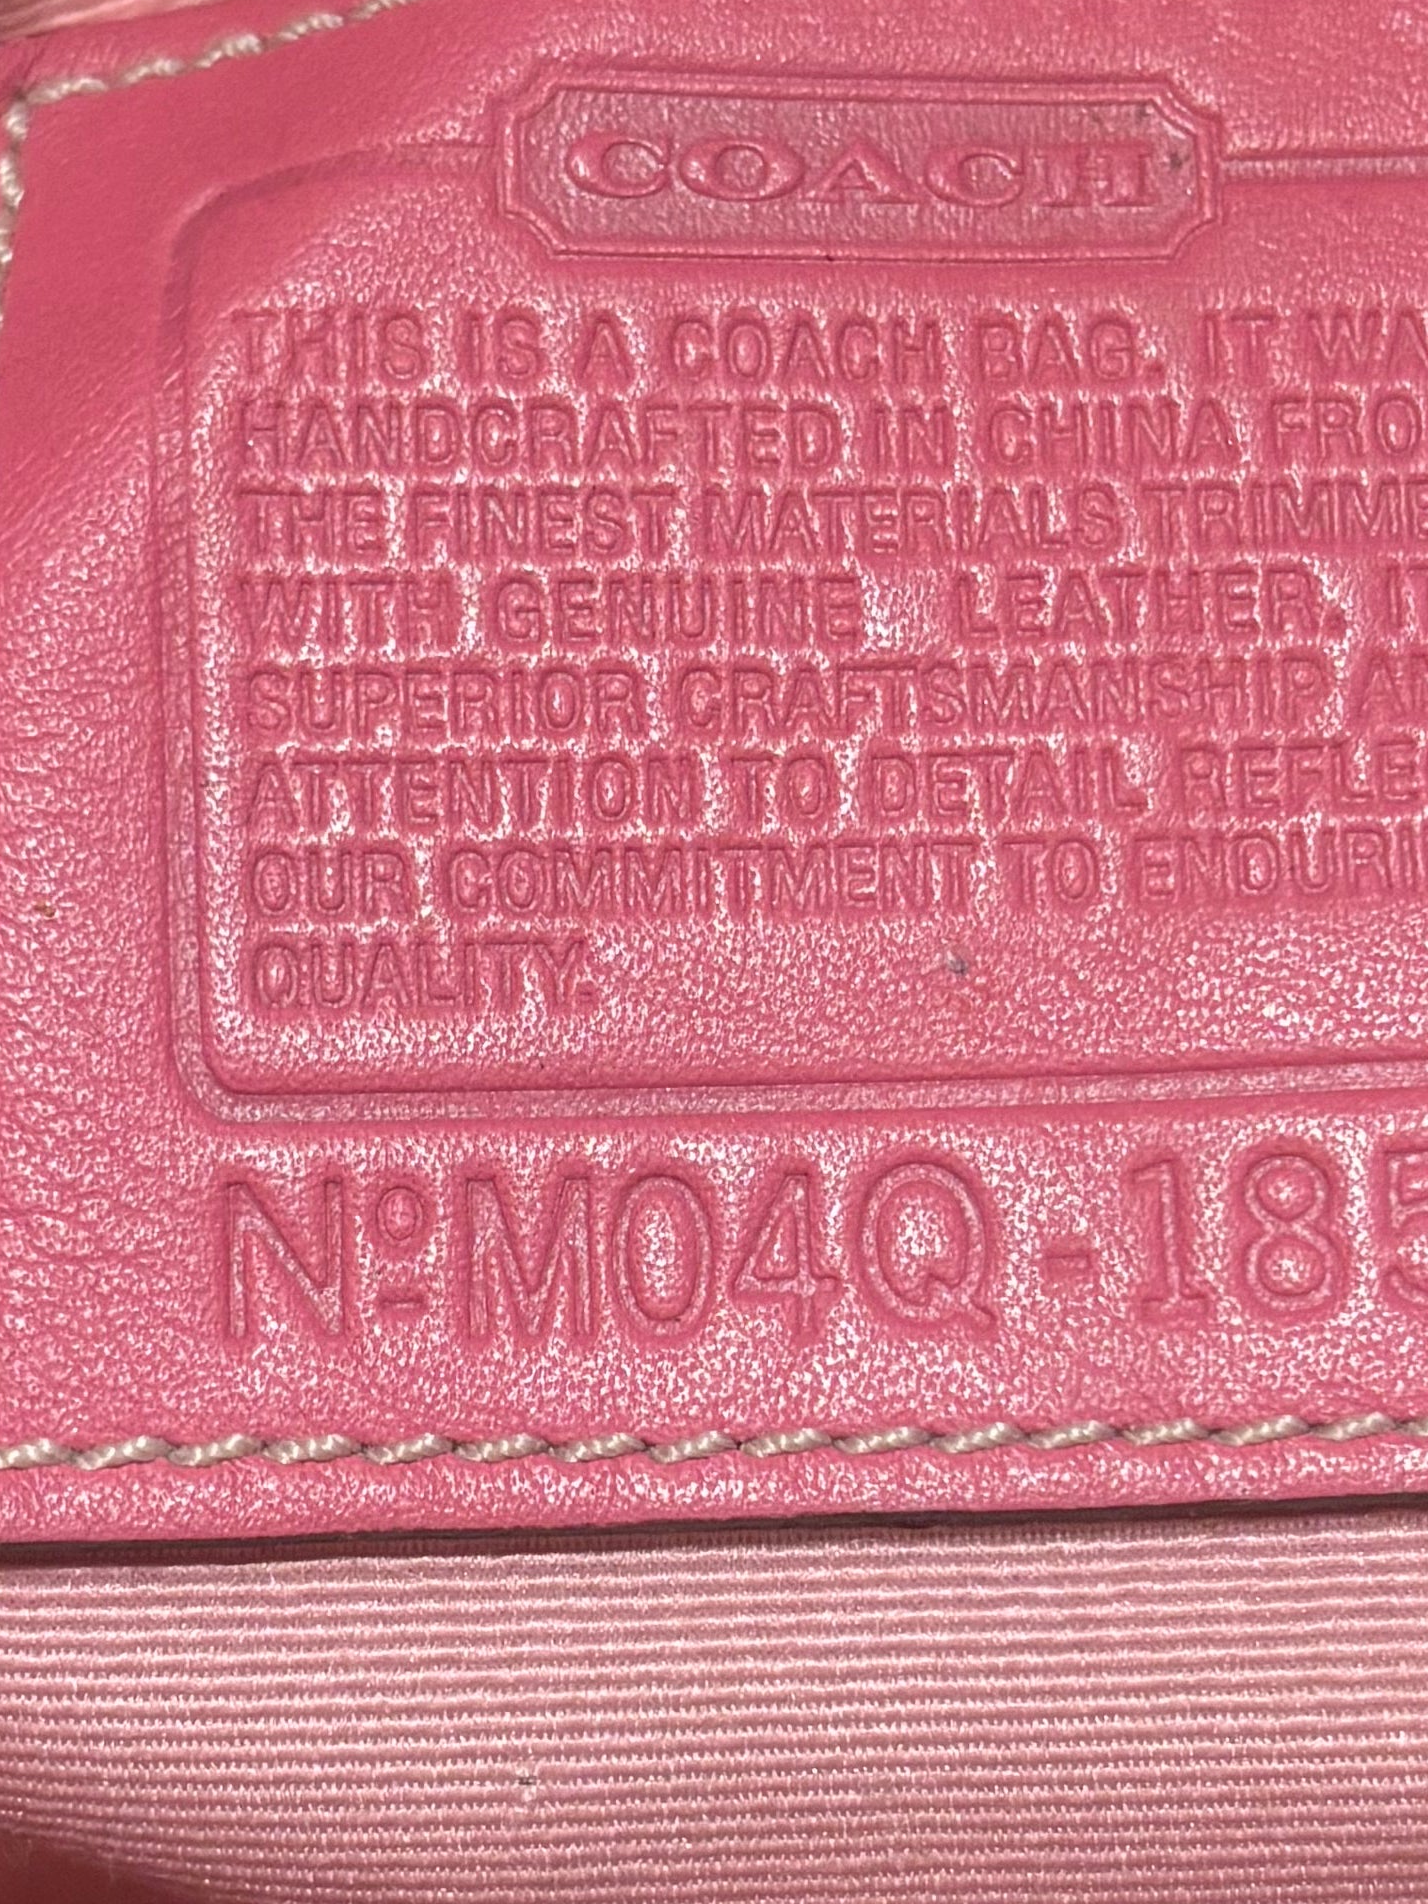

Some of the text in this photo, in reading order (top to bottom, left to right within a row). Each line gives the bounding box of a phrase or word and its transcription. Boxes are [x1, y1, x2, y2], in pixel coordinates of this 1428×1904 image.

[574, 136, 1156, 208] COACH
[230, 308, 430, 382] THIS
[470, 308, 546, 382] IS
[574, 310, 640, 382] A
[672, 310, 942, 382] COACH
[1202, 308, 1276, 380] IT
[234, 400, 840, 470] HANDCRAFTED
[874, 400, 952, 468] IN
[988, 398, 1230, 466] CHINA
[236, 487, 386, 556] THE
[412, 488, 672, 556] FINEST
[708, 486, 1118, 554] MATERIALS
[240, 571, 452, 648] WITH
[494, 571, 862, 646] GENUINE
[246, 662, 646, 738] SUPERIOR
[680, 648, 1324, 734] CRAFTSMANSHIP
[246, 752, 702, 826] ATTENTION
[730, 752, 836, 822] TO
[252, 842, 414, 914] OUR
[444, 838, 974, 914] COMMITMENT
[1002, 836, 1100, 900] TO
